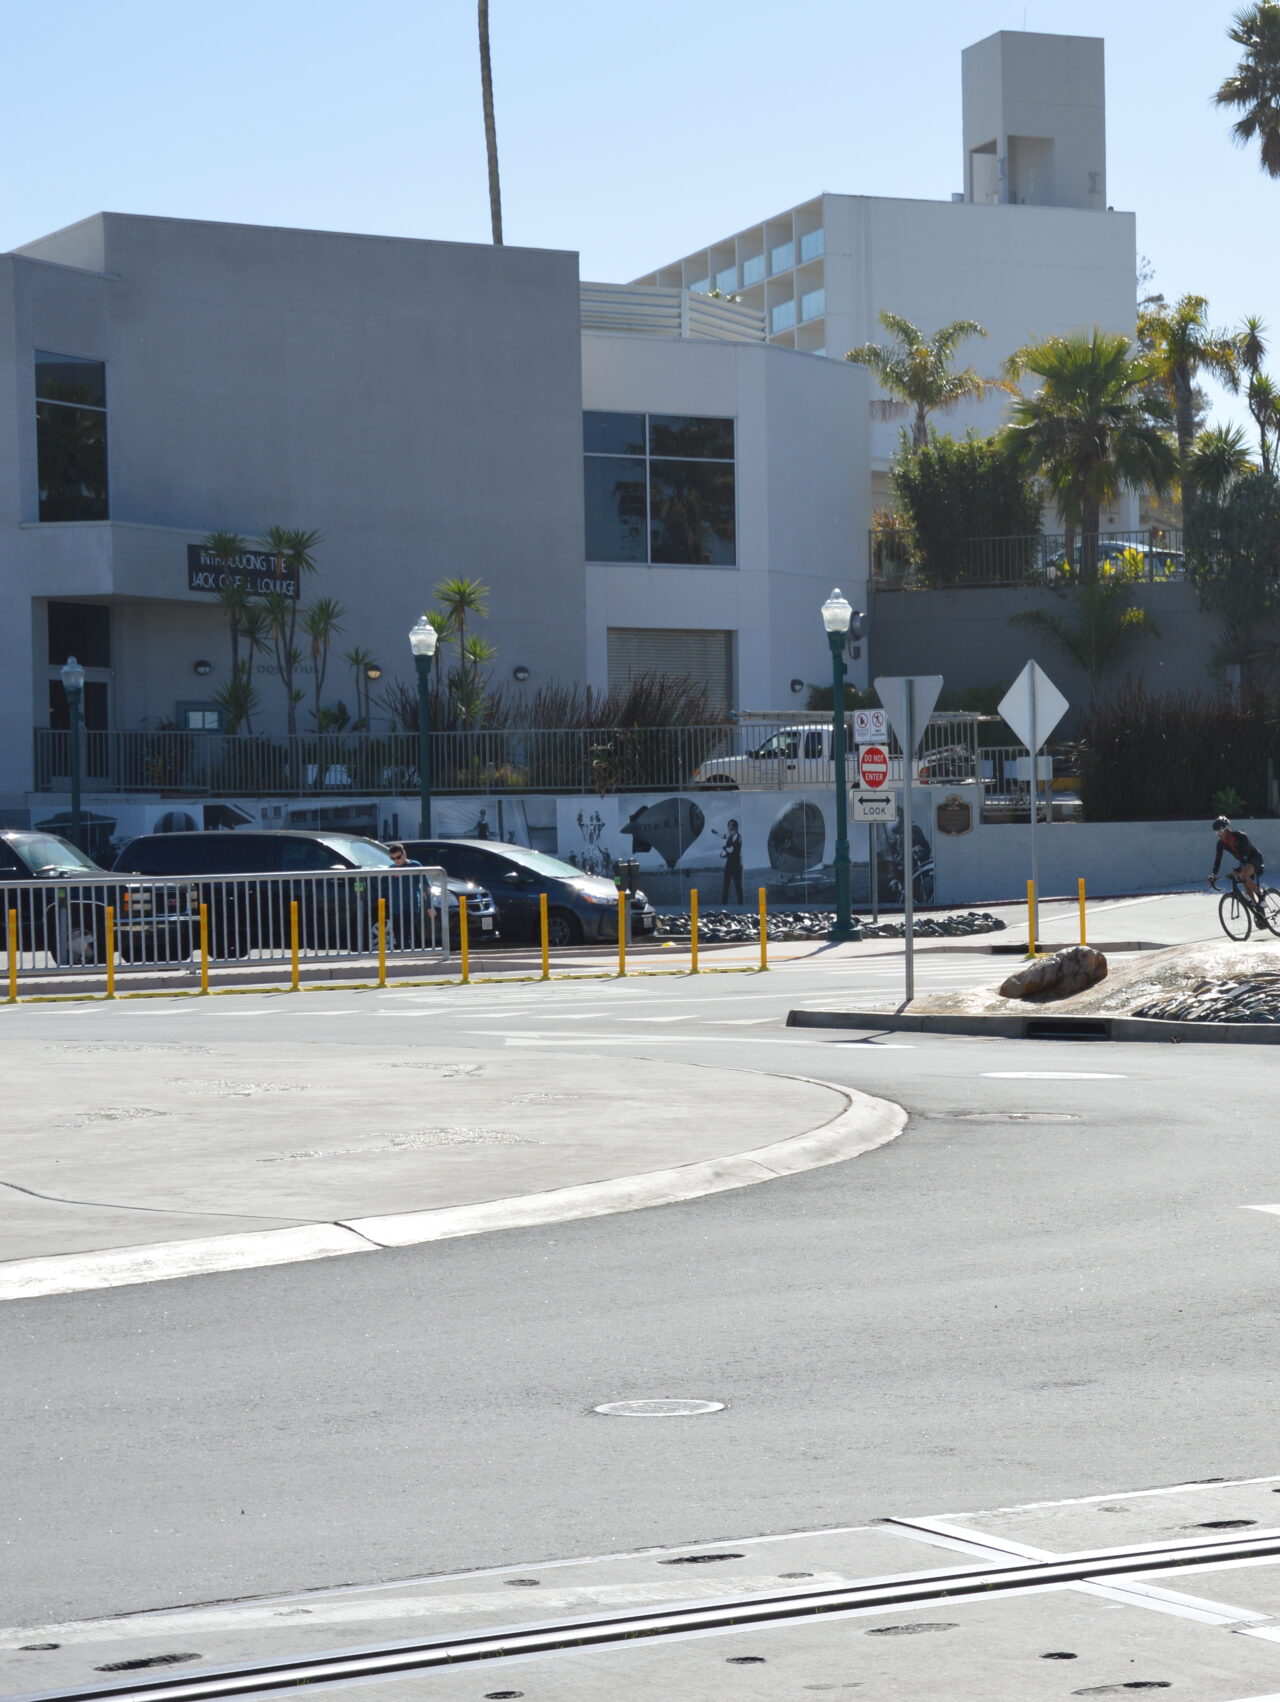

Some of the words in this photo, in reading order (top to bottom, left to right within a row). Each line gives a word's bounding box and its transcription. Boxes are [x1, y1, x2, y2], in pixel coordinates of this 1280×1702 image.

[191, 571, 216, 589] JACK
[864, 754, 872, 762] DO
[865, 773, 884, 781] ENTER
[863, 807, 886, 815] LOOK
